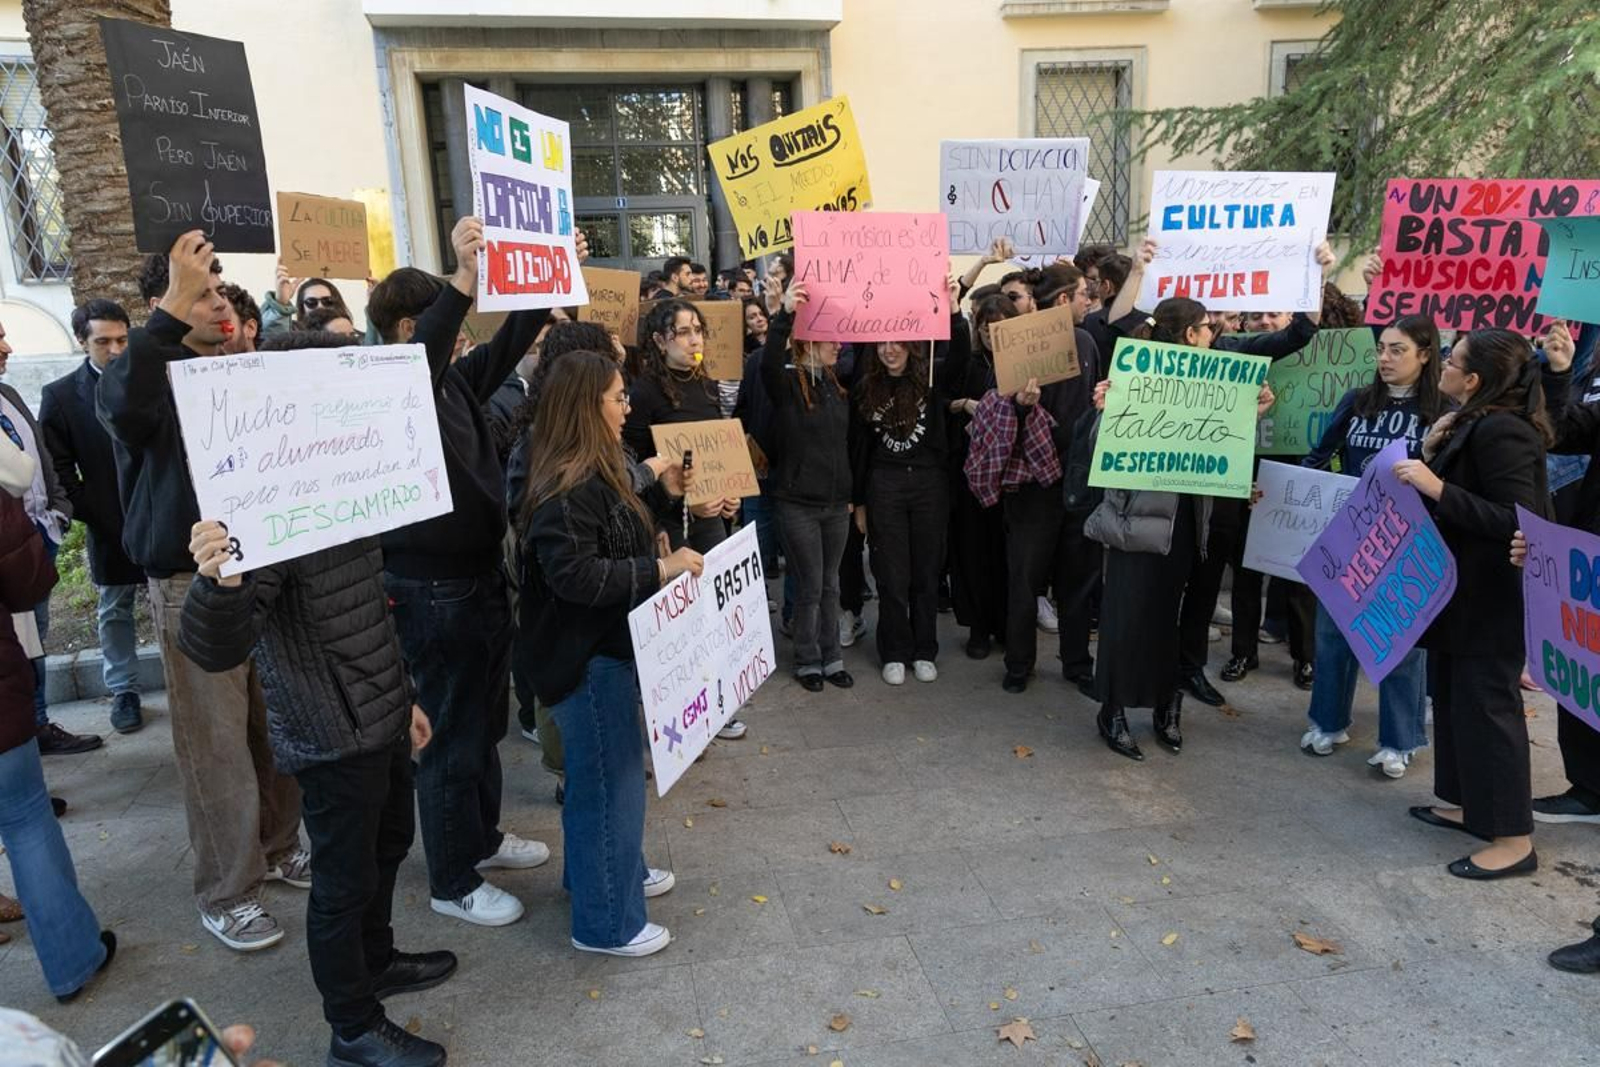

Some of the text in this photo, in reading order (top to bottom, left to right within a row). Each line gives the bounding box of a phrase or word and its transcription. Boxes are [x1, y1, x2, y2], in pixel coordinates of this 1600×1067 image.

[474, 103, 506, 156] NO
[156, 136, 194, 165] PERO
[1022, 176, 1076, 212] HAY
[1409, 182, 1580, 218] UN 20% NO
[801, 221, 831, 248] La
[1162, 202, 1296, 231] CULTURA
[748, 224, 769, 254] NO
[872, 257, 891, 285] de
[908, 258, 929, 285] la
[1157, 270, 1270, 299] FUTURO
[1382, 255, 1517, 292] MÚSICA
[1116, 344, 1268, 387] CONSERVATORIO
[1127, 375, 1238, 413] ABANDONADO
[201, 387, 297, 450] Mucho
[1104, 404, 1247, 443] talento
[1101, 451, 1229, 476] DESPERDICIADO
[223, 486, 279, 523] pero
[289, 478, 320, 498] nos
[1284, 480, 1322, 510] LA
[263, 483, 422, 546] DESCAMPADO
[1340, 497, 1411, 601] MERECE
[713, 550, 761, 612] BASTA
